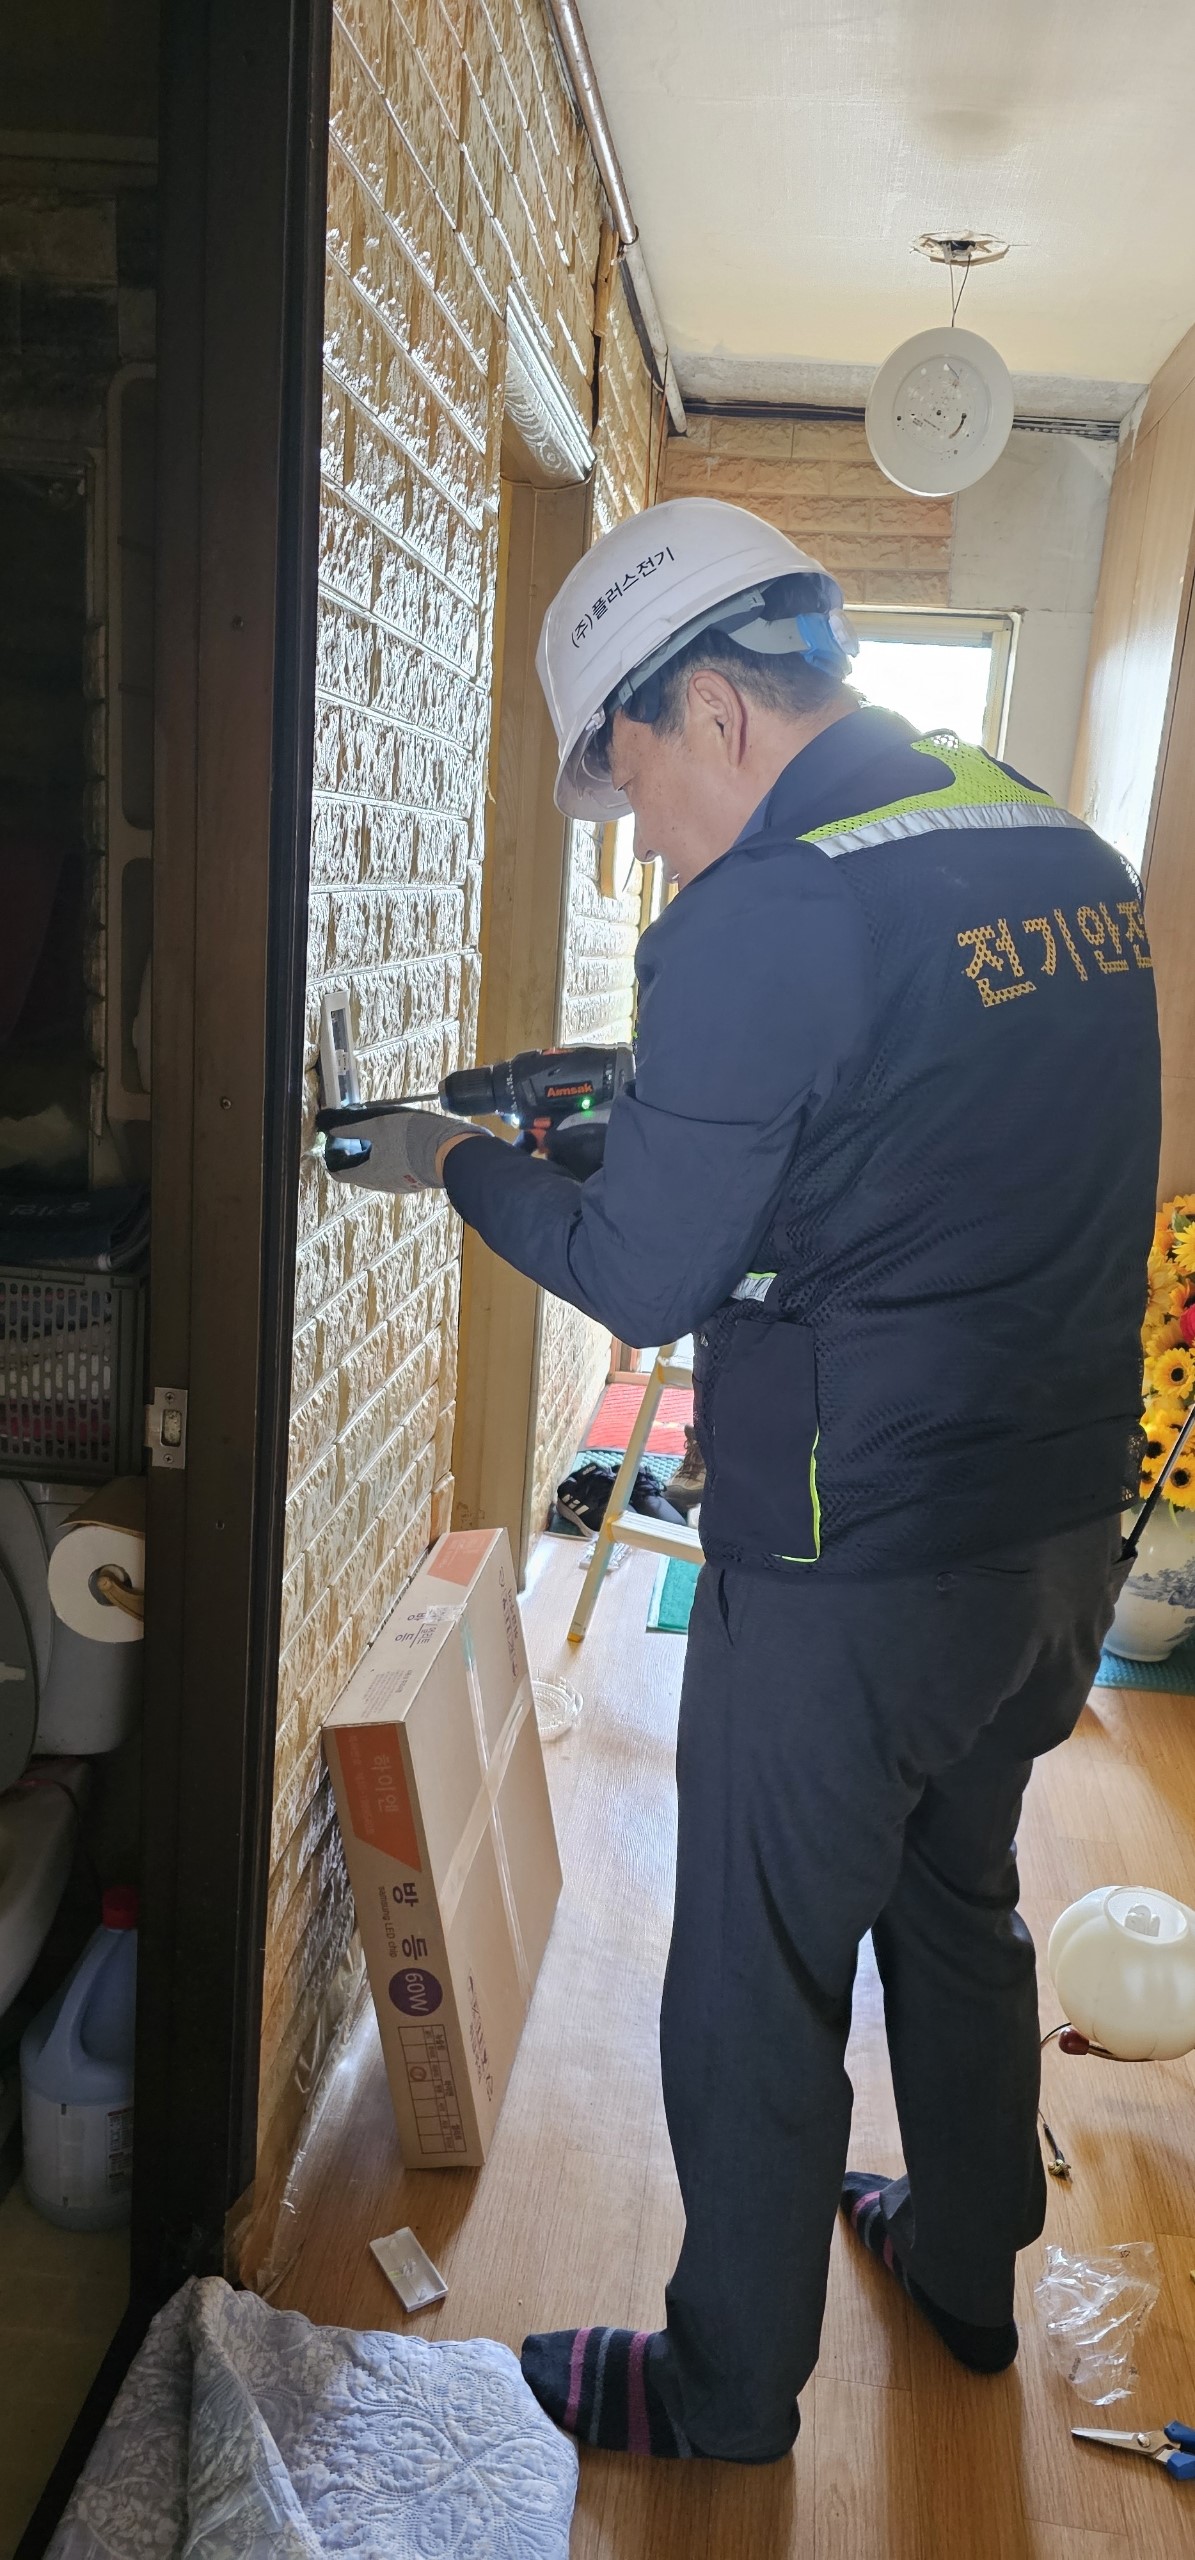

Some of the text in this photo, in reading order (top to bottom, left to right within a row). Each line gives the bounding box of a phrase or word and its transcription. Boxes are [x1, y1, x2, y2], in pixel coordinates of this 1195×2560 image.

[571, 546, 675, 648] (주)플러스전기
[546, 1083, 593, 1098] Aimsak
[370, 1754, 400, 1814] 하이엔
[385, 1922, 396, 1940] LED
[405, 1973, 429, 2012] 60W
